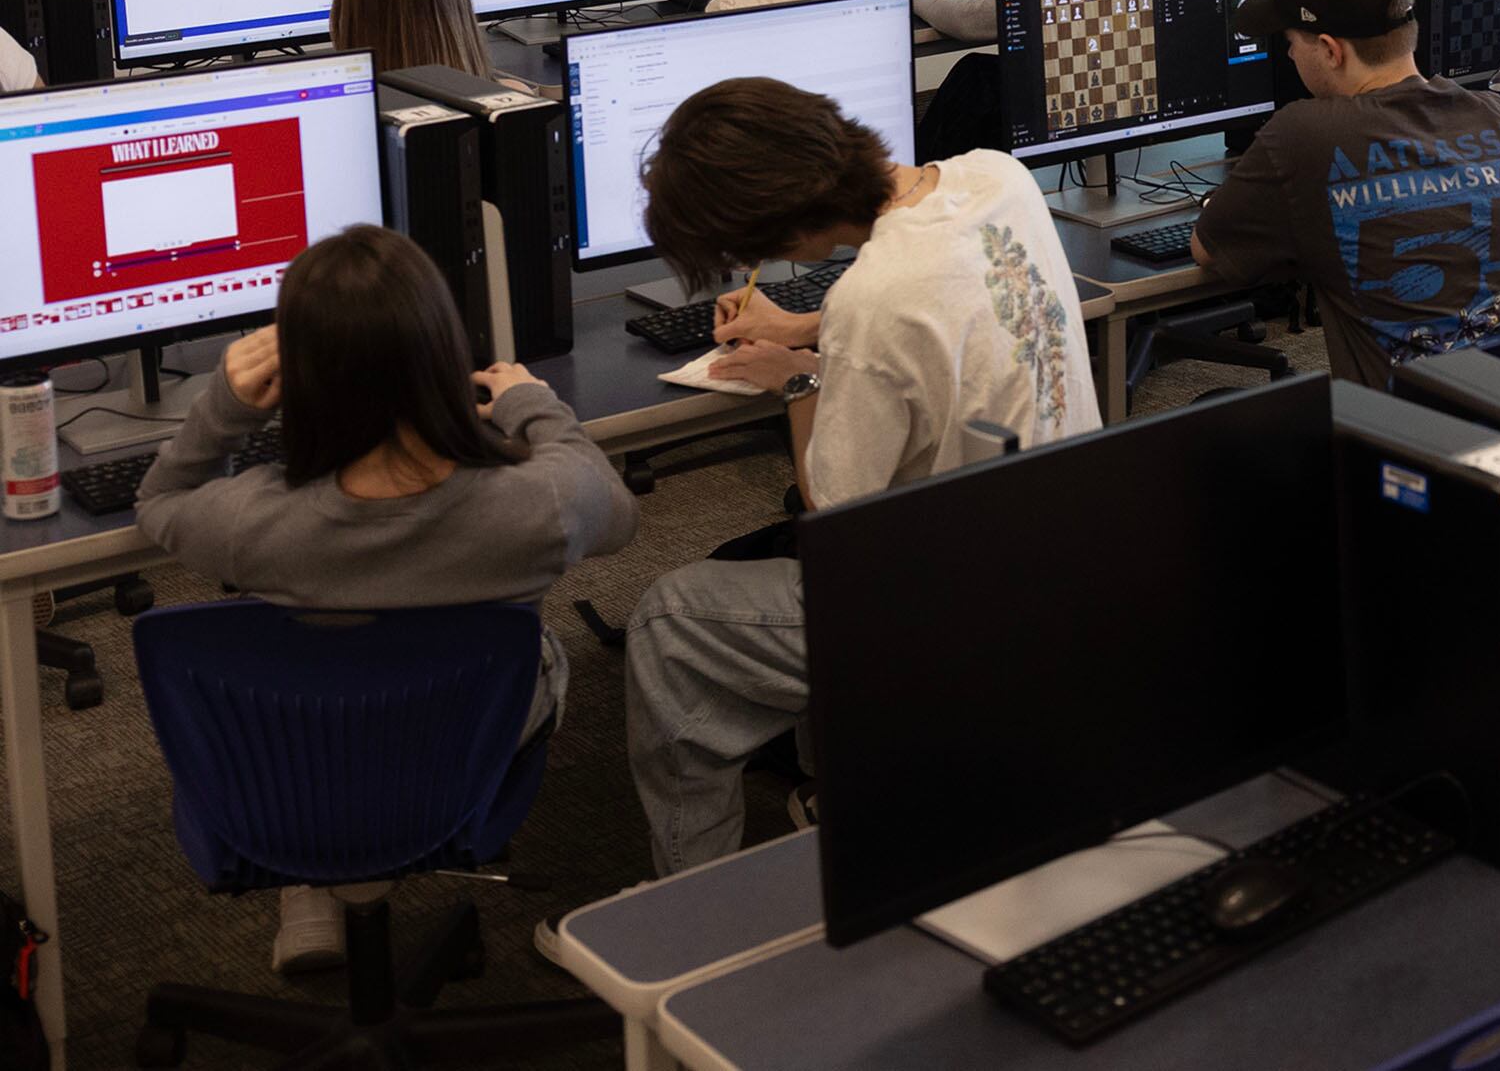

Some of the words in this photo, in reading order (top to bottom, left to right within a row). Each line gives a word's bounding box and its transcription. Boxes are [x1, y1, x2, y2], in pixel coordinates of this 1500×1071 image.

[111, 140, 151, 163] WHAT
[152, 139, 159, 158] I
[160, 131, 219, 157] LEARNED
